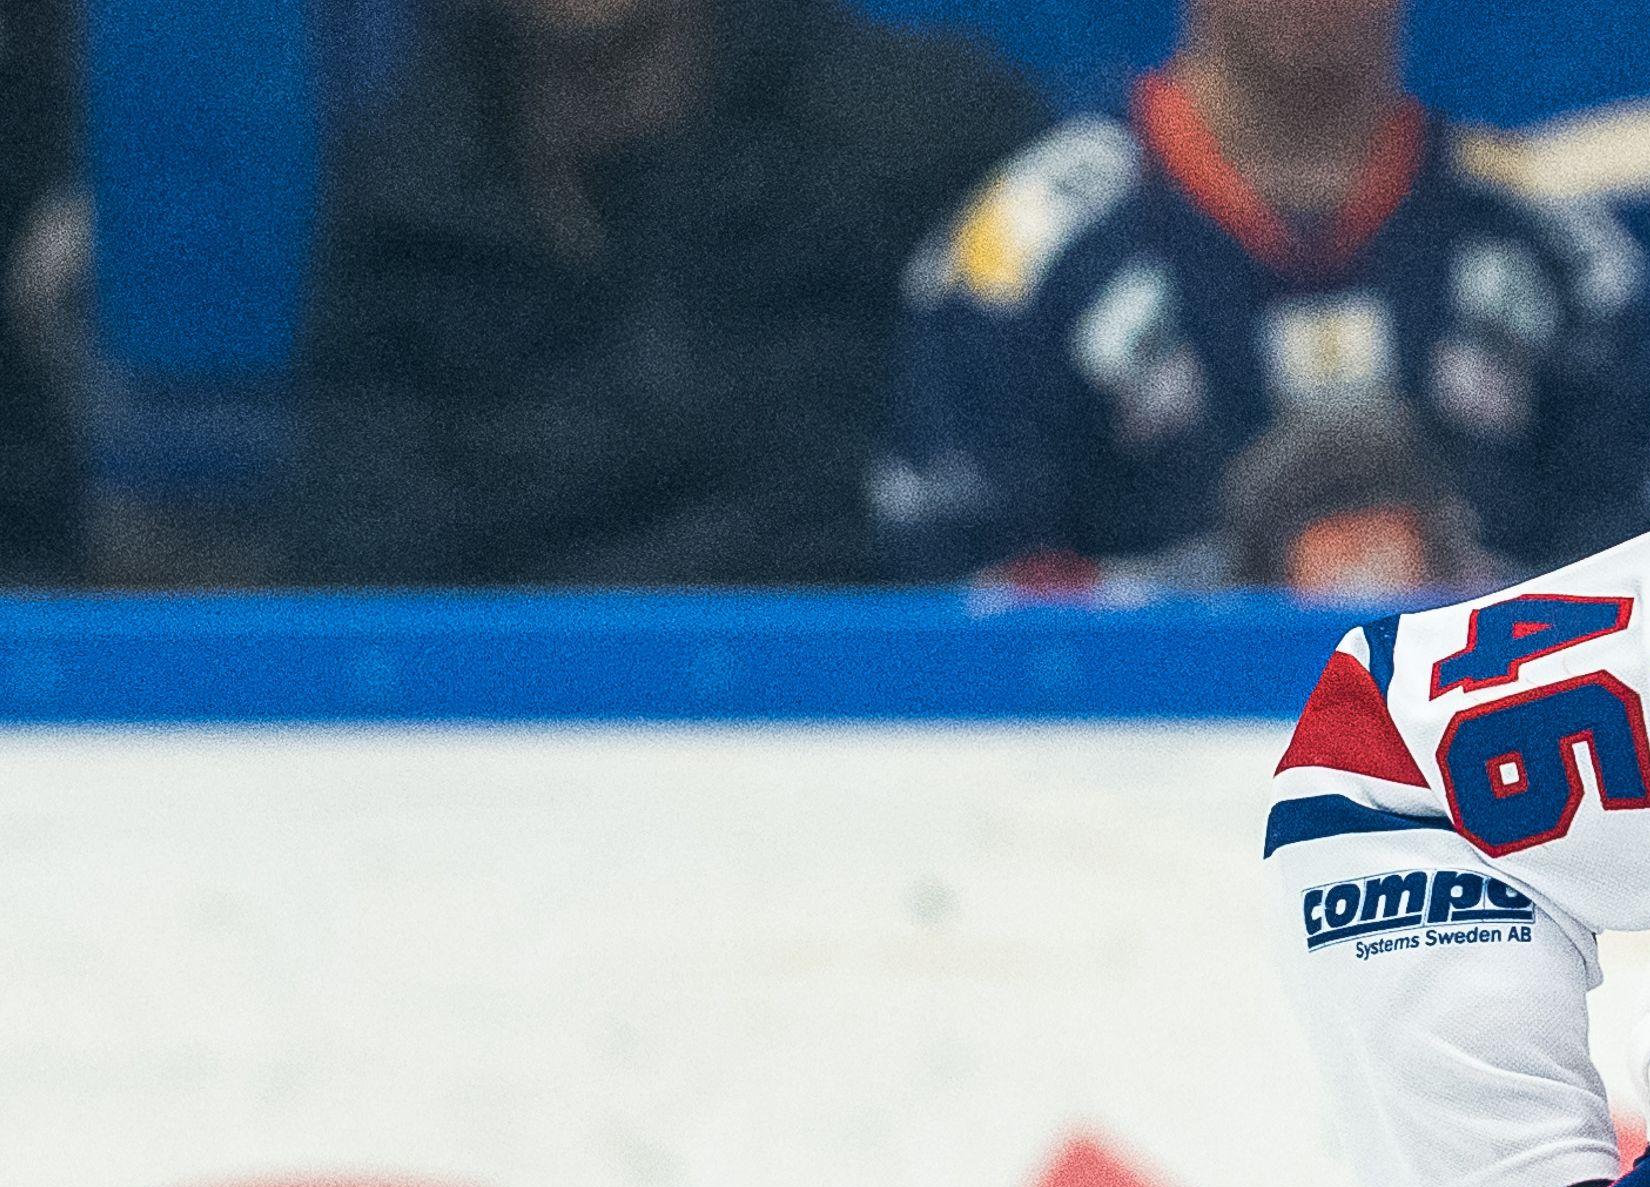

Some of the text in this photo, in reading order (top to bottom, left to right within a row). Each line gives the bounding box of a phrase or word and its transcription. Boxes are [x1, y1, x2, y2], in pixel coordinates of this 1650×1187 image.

[1355, 925, 1532, 960] Systems Sweden AB
